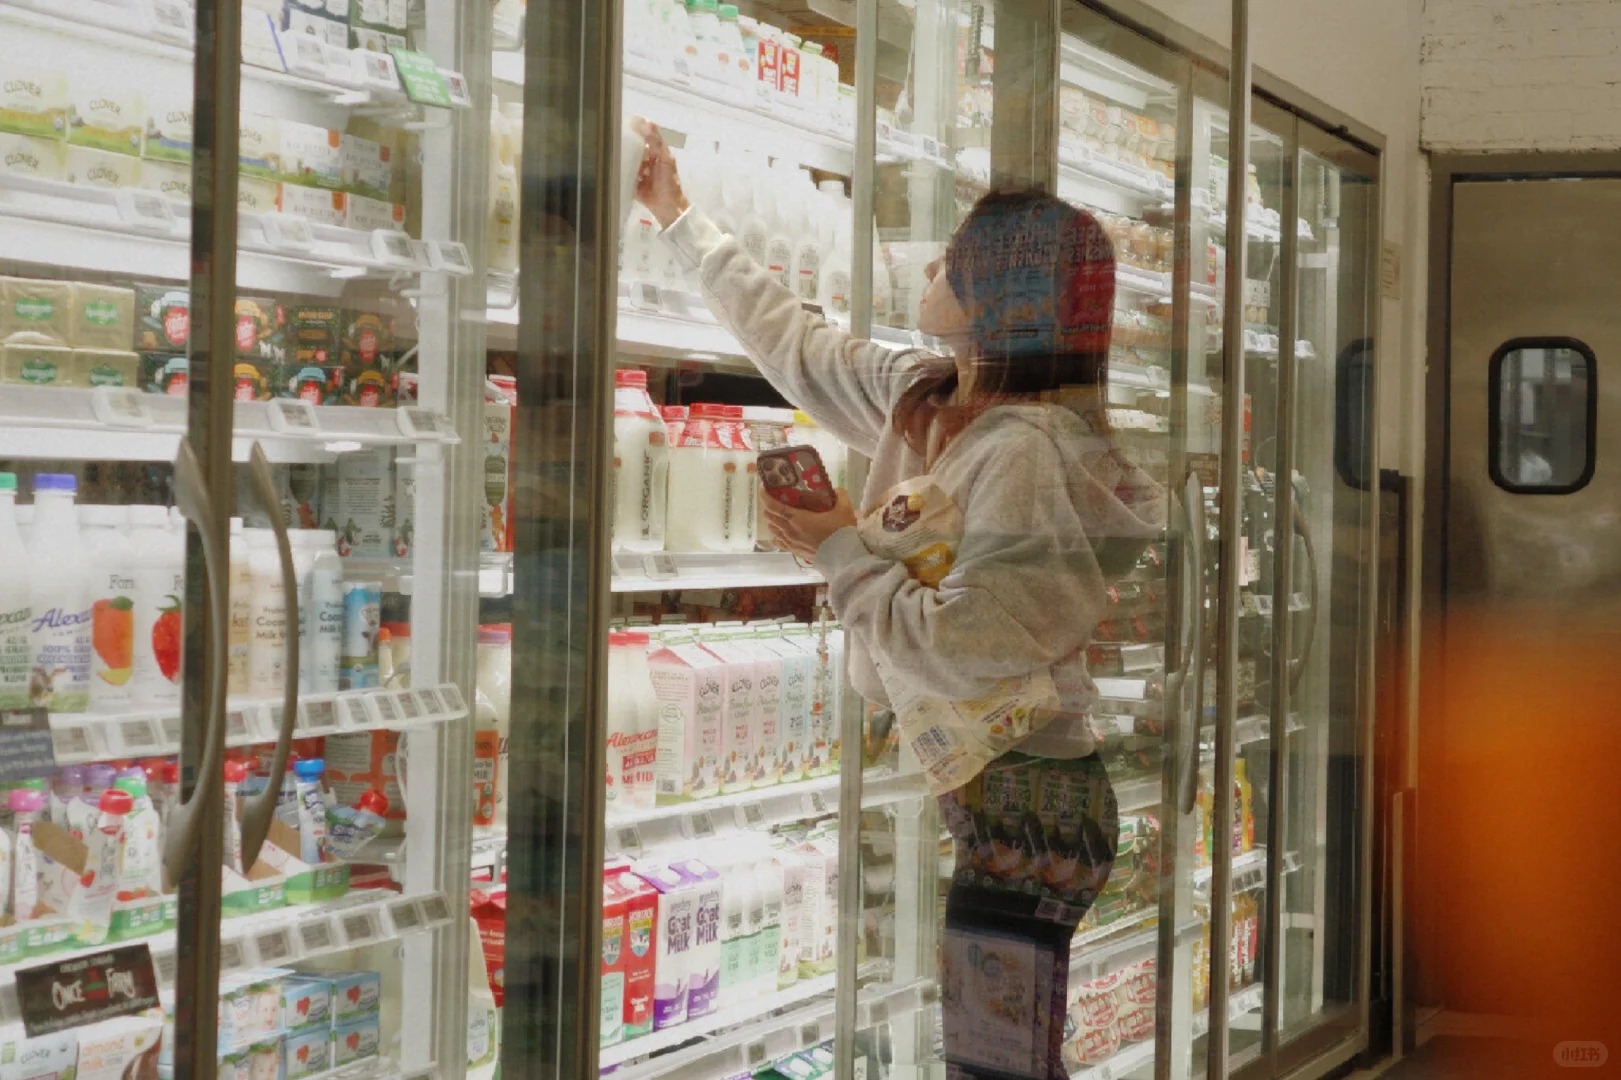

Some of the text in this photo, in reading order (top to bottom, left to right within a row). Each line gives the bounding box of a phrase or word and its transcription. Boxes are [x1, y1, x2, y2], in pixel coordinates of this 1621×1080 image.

[4, 80, 42, 97] CLOVER
[89, 98, 121, 116] CLOVER
[5, 152, 39, 169] CLOVER
[86, 166, 119, 185] CLOVER
[668, 913, 691, 935] Goat
[696, 903, 719, 925] Goat
[668, 932, 691, 955] Milk
[696, 921, 718, 946] Milk
